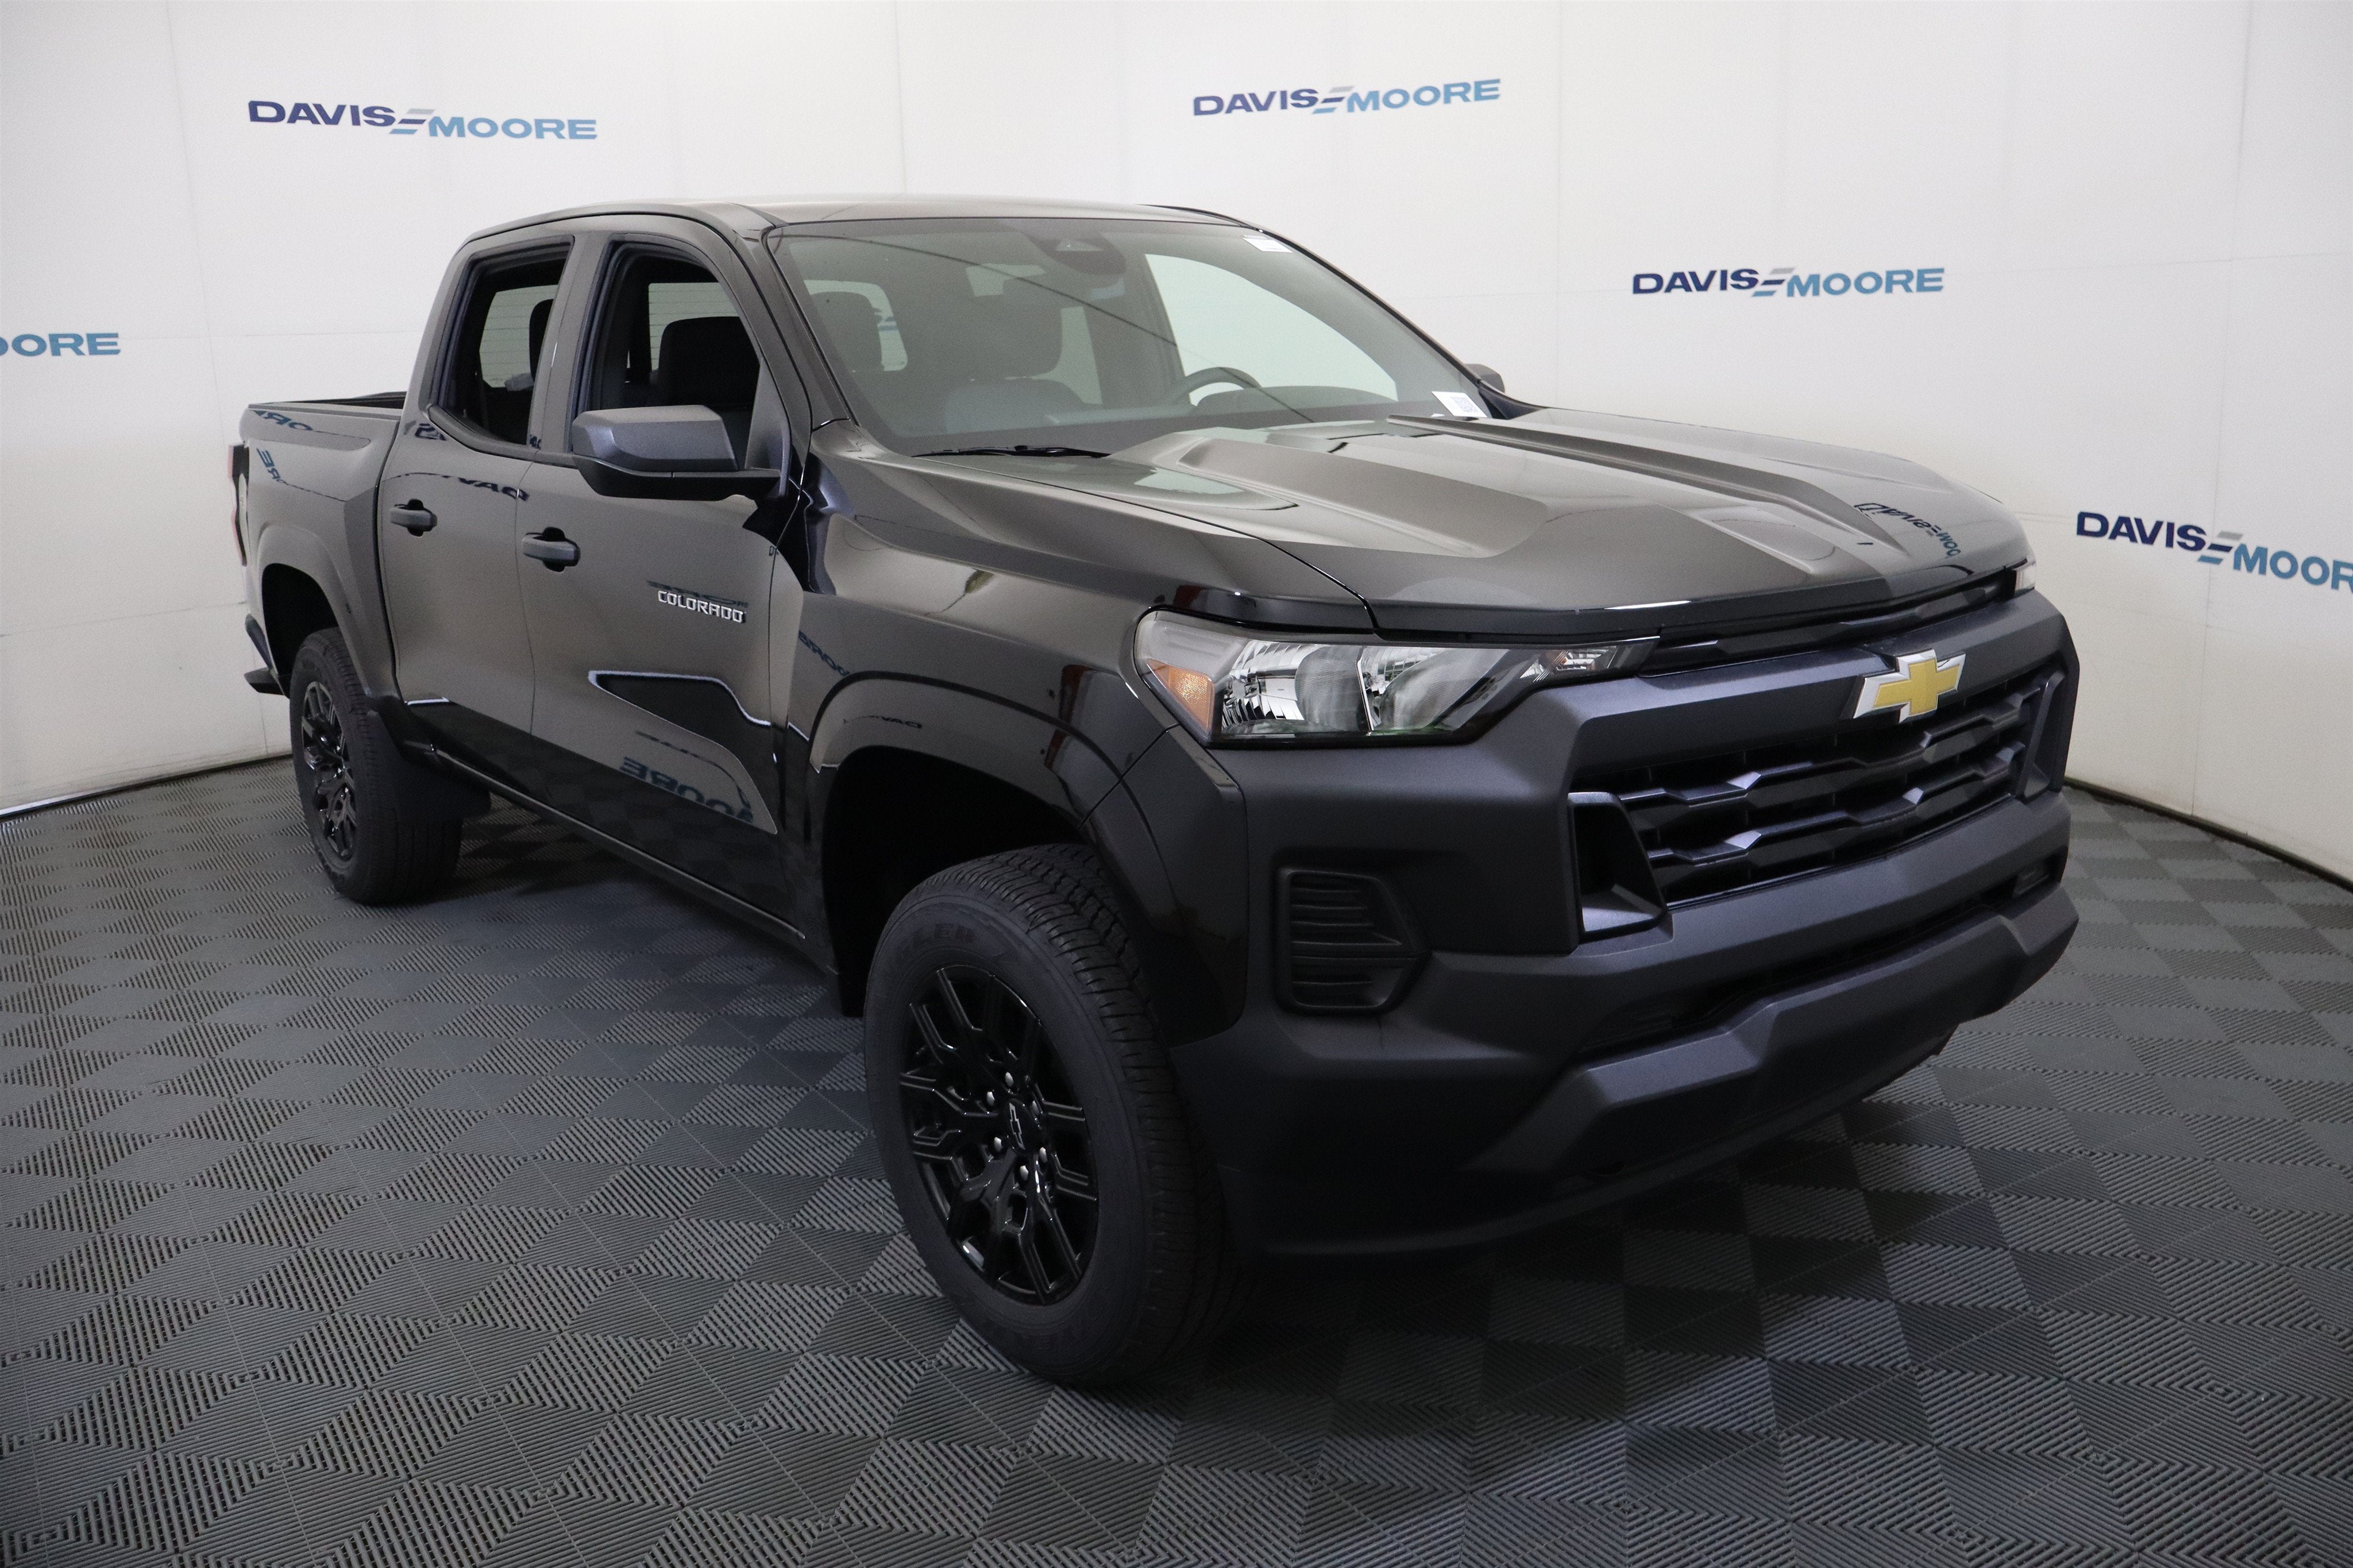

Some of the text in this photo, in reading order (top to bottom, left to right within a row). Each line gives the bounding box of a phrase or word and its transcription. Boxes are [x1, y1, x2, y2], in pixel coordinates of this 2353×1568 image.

[1193, 79, 1500, 115] DAVIS MOORE
[248, 101, 597, 140] DAVIS MOORE
[1632, 268, 1945, 297] DAVIS MOORE
[0, 333, 121, 357] ORE
[2076, 511, 2207, 551] DAVIS
[657, 590, 743, 623] COLORADO
